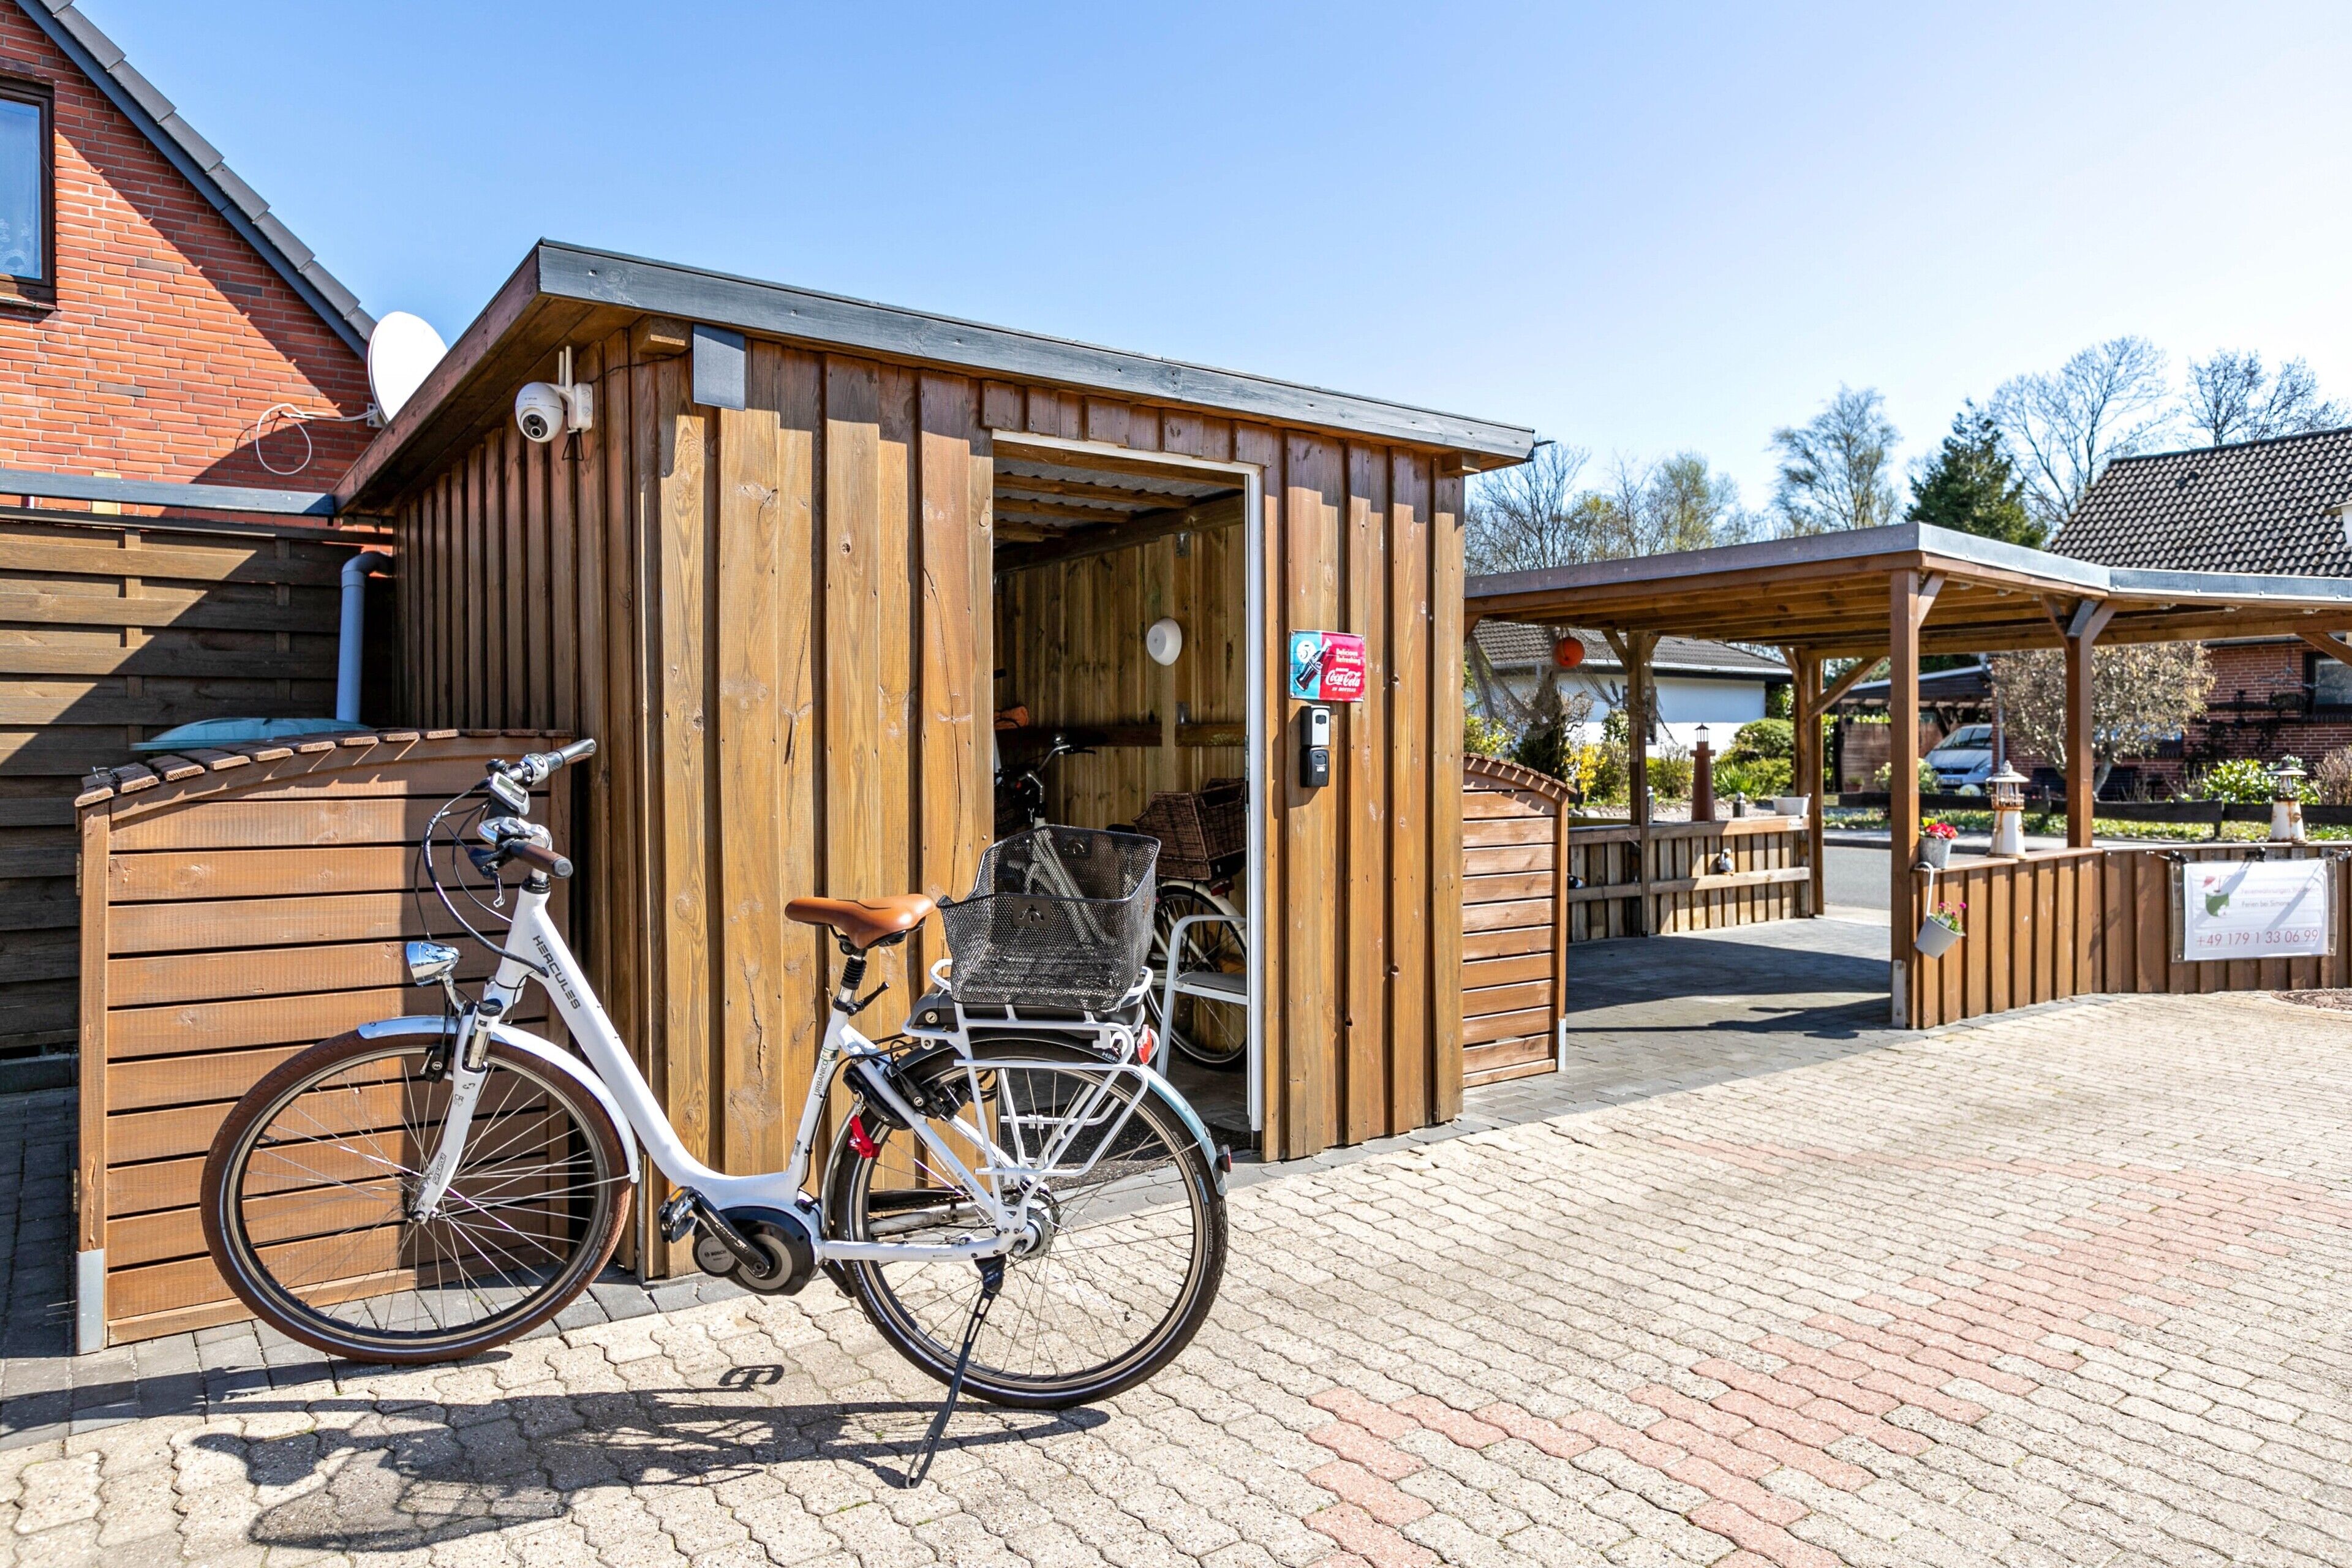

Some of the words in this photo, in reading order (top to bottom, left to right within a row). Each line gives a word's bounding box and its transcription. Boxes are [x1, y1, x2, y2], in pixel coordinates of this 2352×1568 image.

[2197, 933, 2222, 946] +49
[2228, 932, 2250, 945] 179
[2255, 932, 2260, 944] 1
[2266, 930, 2280, 944] 33
[2284, 930, 2300, 943] 06
[2304, 929, 2319, 942] 99
[532, 935, 581, 1010] HERCULES
